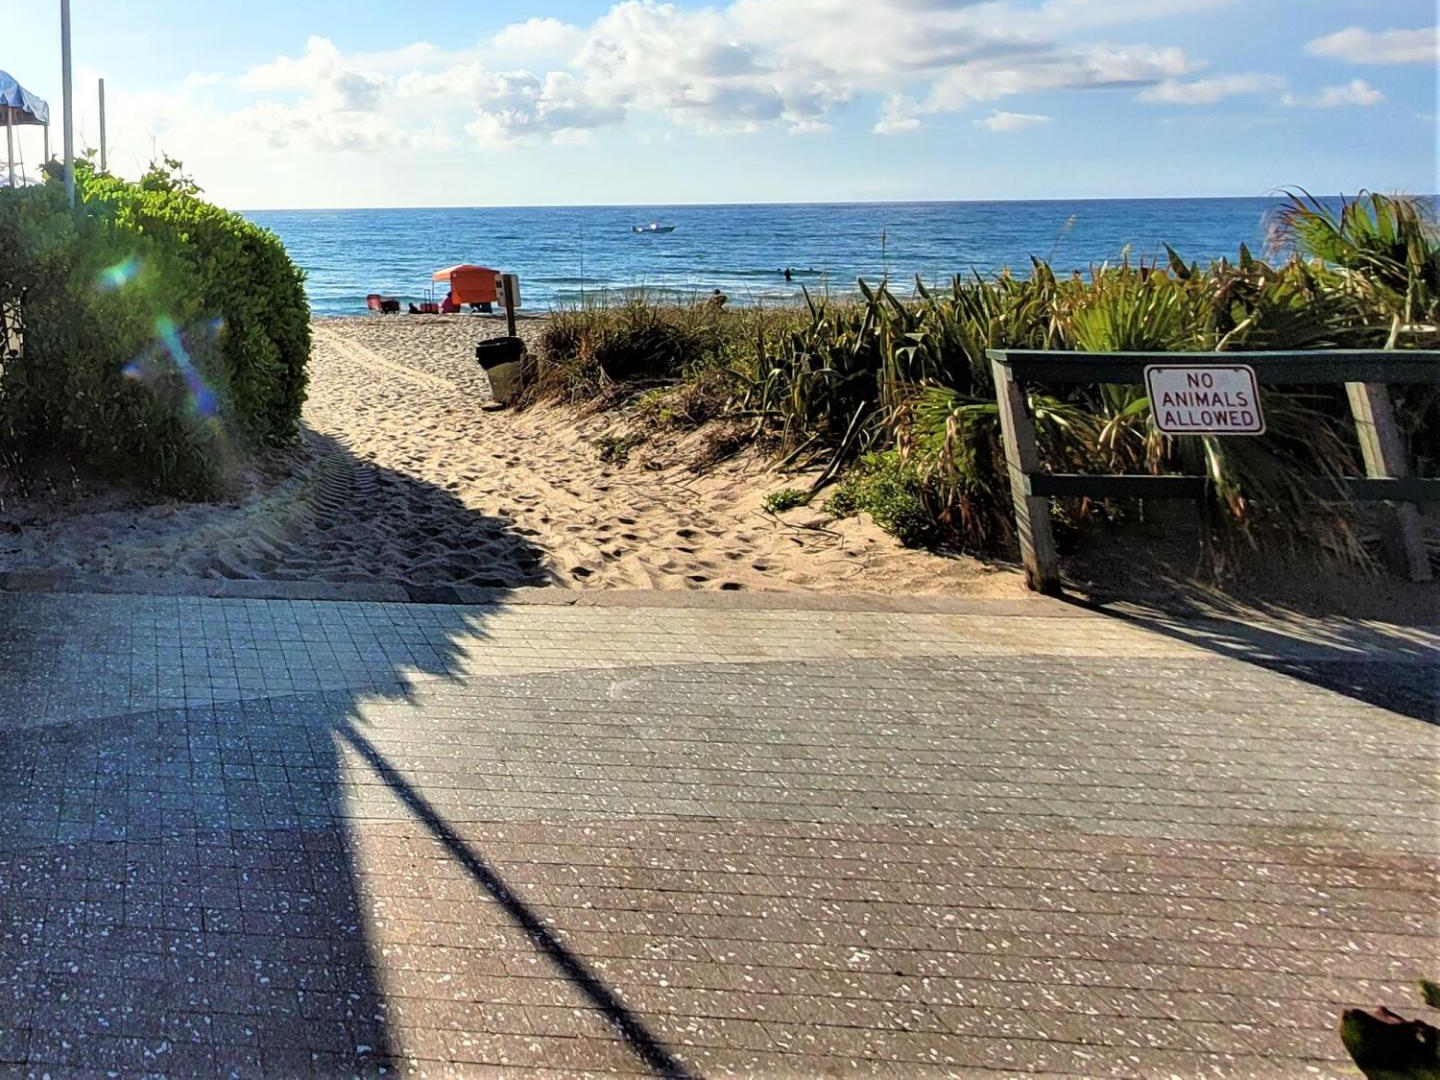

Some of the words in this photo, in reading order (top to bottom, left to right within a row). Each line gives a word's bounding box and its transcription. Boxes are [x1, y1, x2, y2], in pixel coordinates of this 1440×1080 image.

[1186, 372, 1213, 388] NO
[1162, 391, 1248, 407] ANIMALS
[1164, 410, 1254, 426] ALLOWED
